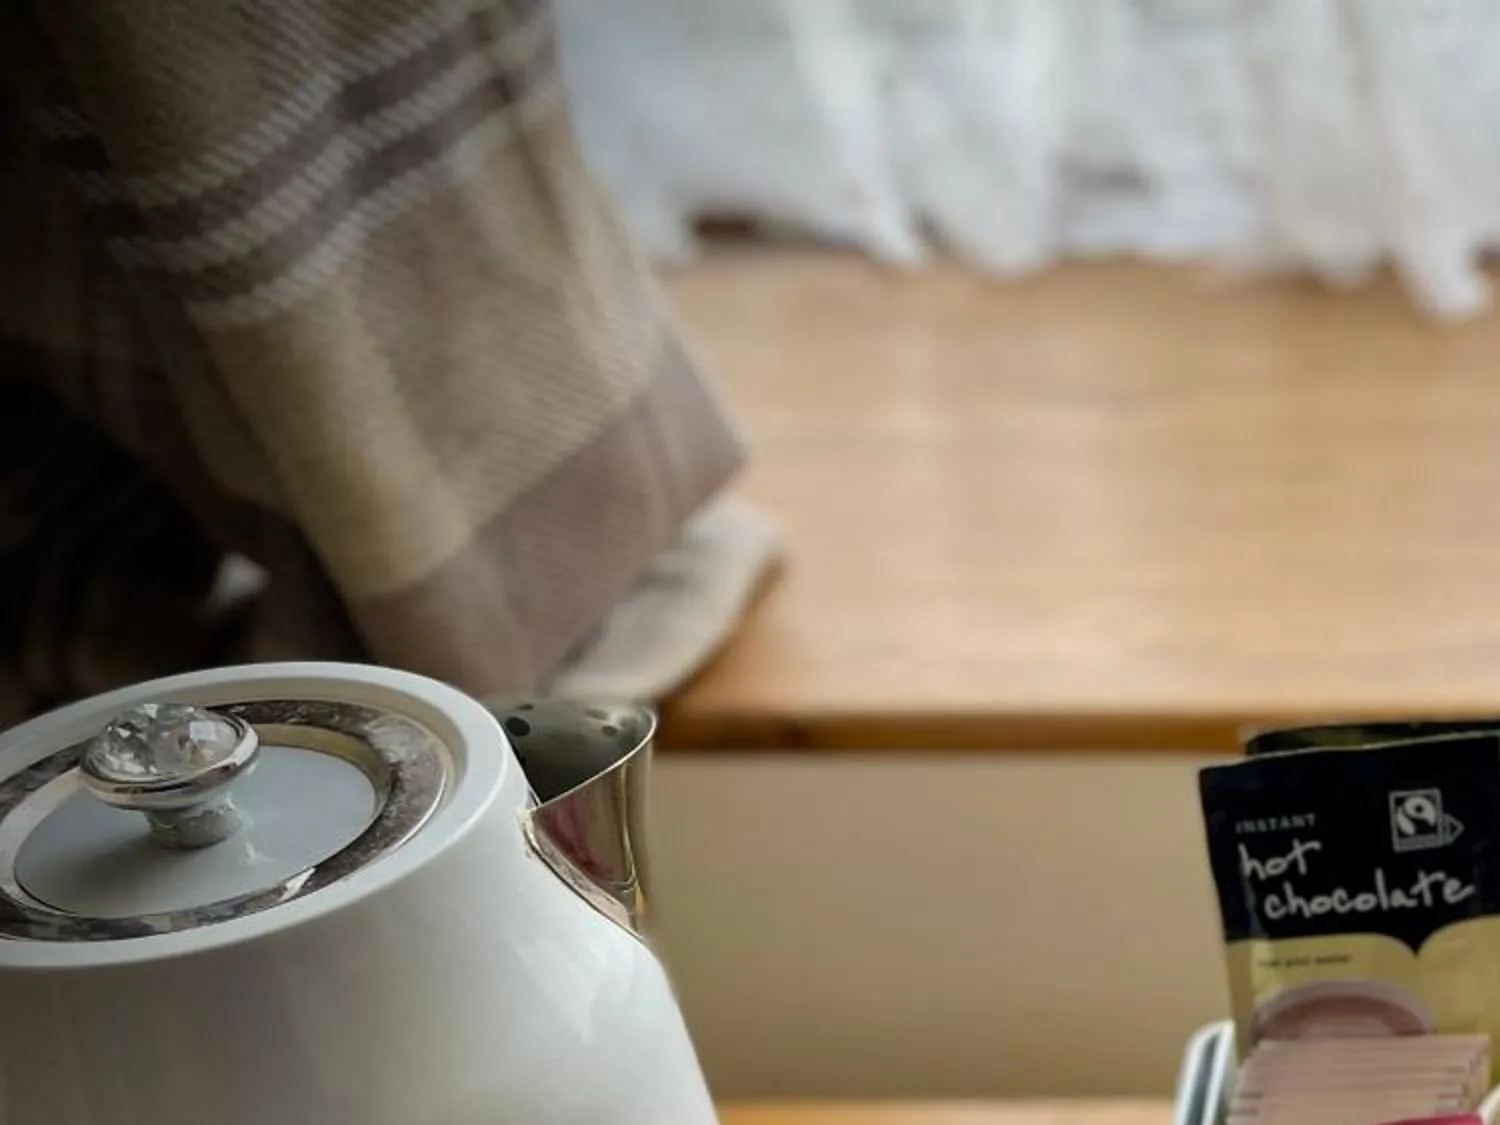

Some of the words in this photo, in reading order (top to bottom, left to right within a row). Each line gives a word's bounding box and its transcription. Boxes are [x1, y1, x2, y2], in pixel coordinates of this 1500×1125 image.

[1235, 812, 1316, 834] INSTANT
[1238, 838, 1322, 880] hot
[1264, 868, 1476, 919] chocolate
